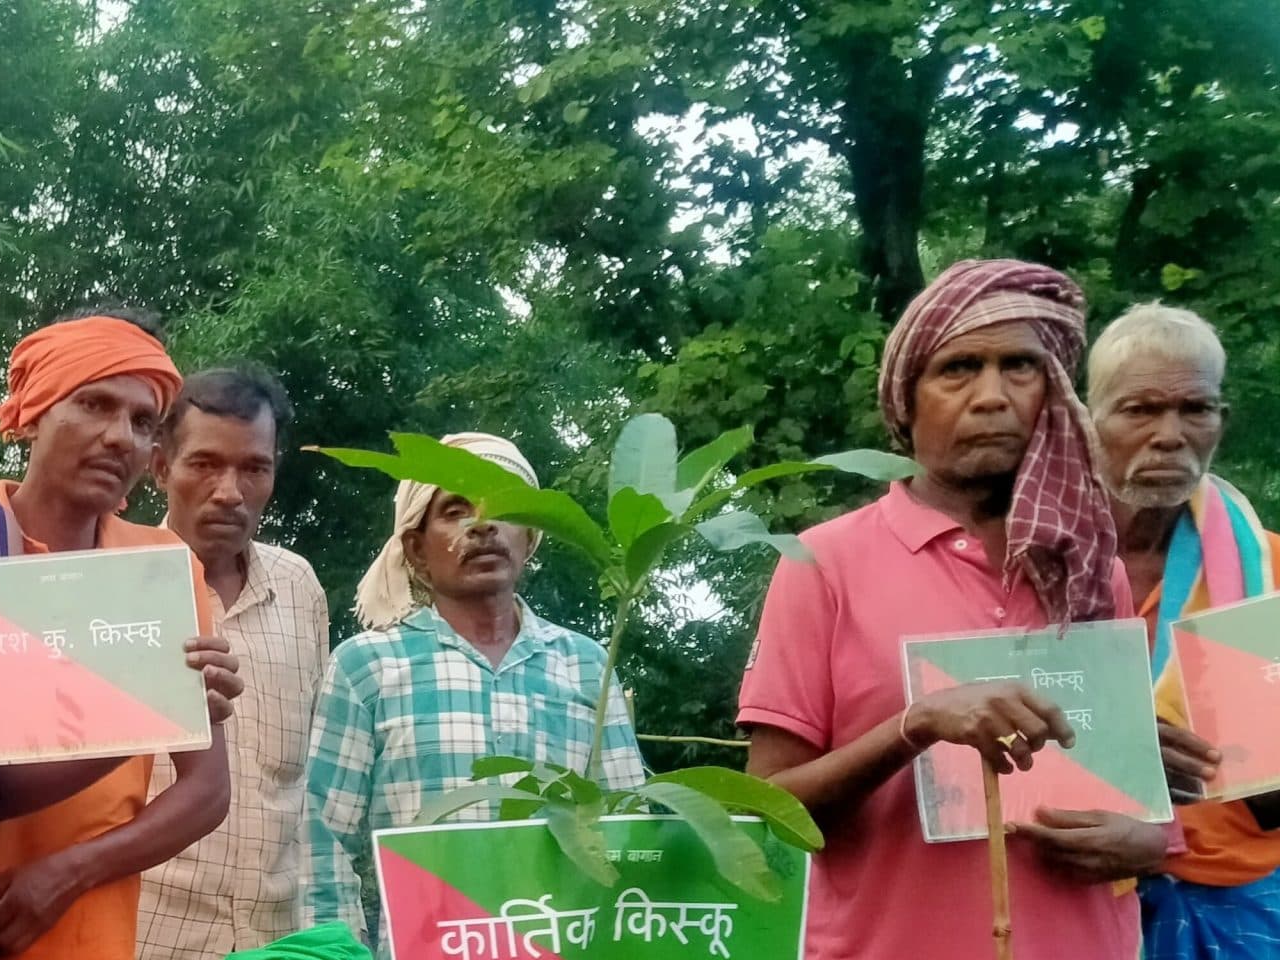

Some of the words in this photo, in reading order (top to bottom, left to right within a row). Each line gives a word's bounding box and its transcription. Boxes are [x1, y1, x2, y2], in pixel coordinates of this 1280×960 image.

[43, 629, 75, 658] कु.
[89, 618, 162, 648] किस्कू
[1031, 667, 1084, 692] किस्कू
[613, 887, 738, 959] किस्कू
